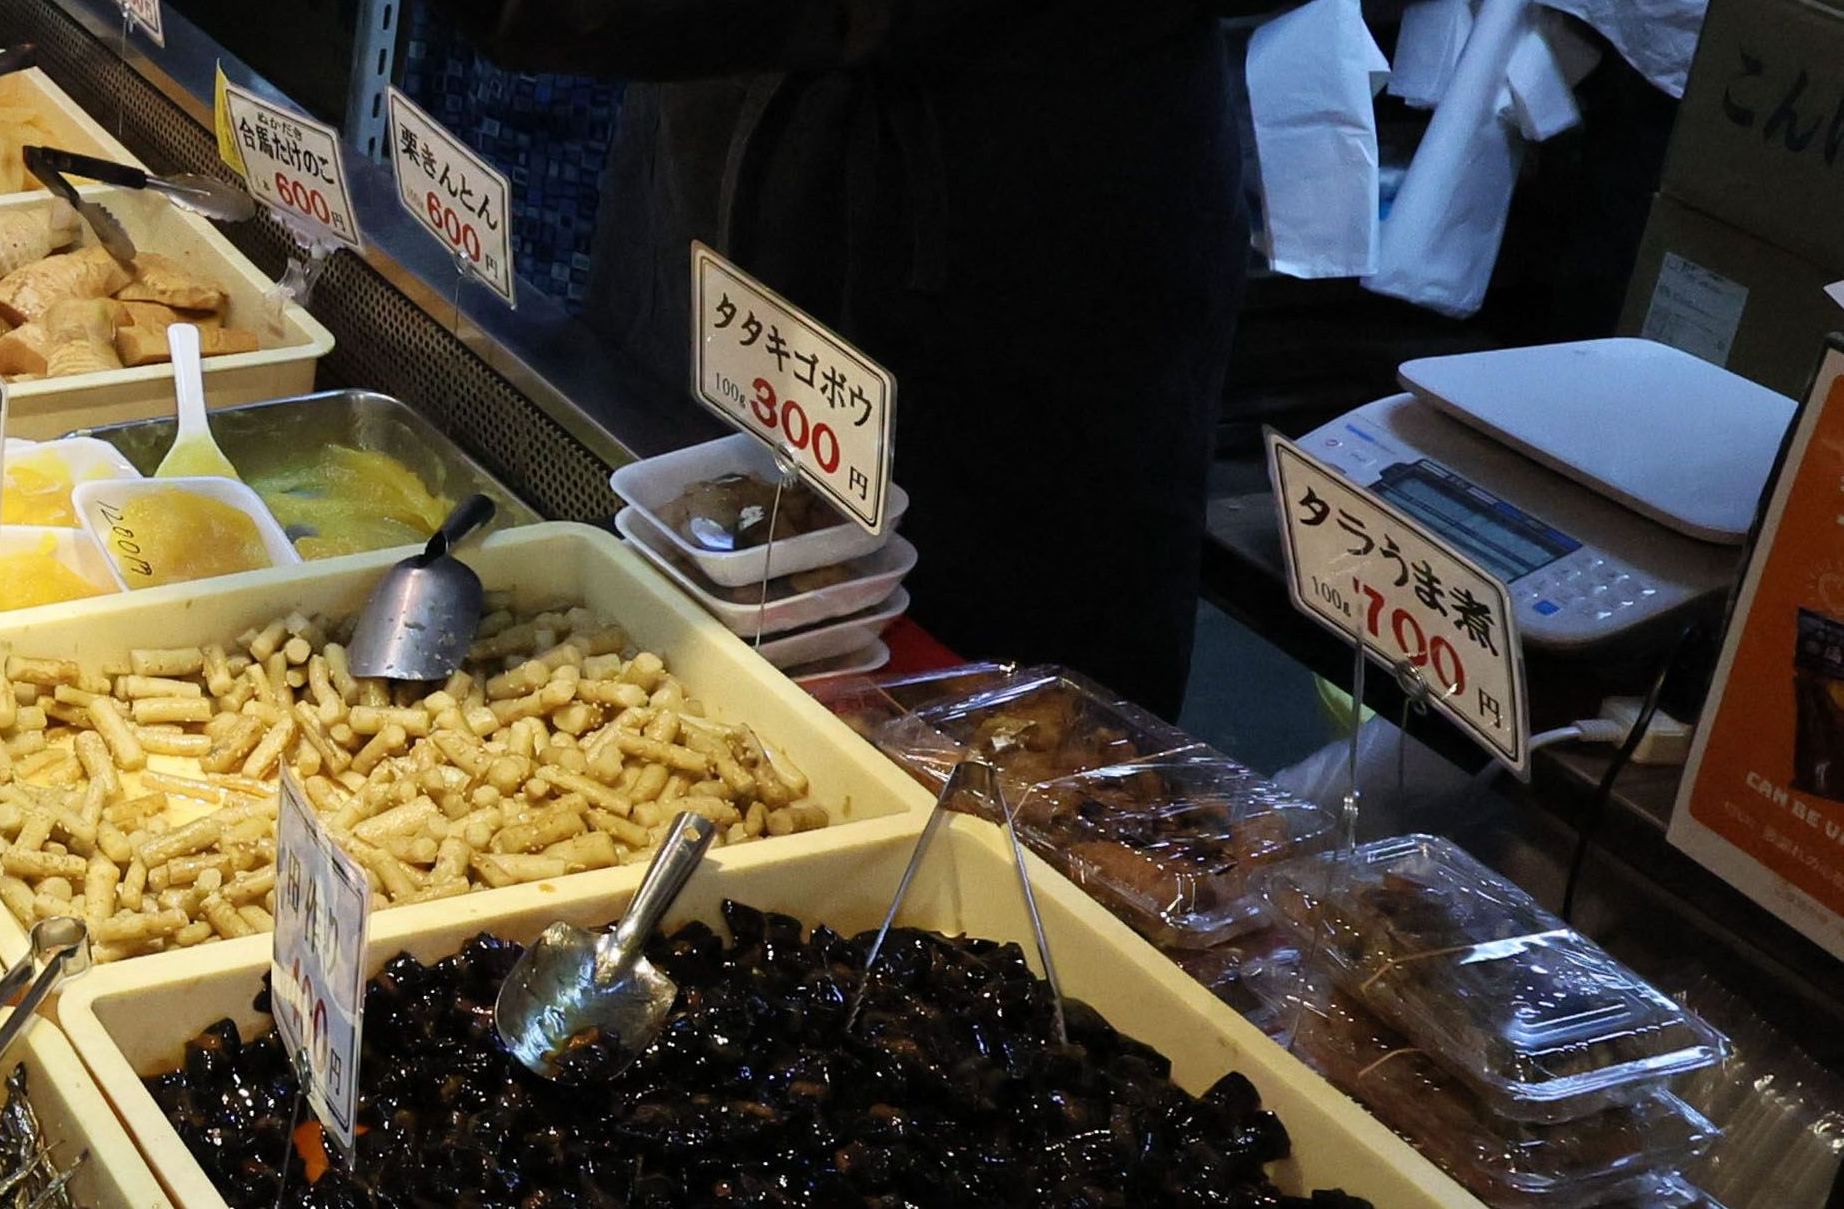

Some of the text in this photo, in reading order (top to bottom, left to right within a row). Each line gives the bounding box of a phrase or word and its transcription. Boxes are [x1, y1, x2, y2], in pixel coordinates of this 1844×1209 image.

[239, 117, 336, 185] 合馬たけのこ
[399, 122, 498, 231] 栗きんとん
[714, 293, 873, 427] タタキゴボウ
[1298, 486, 1500, 657] タラうま煮
[1746, 770, 1789, 807] CAN
[1790, 800, 1820, 828] BE
